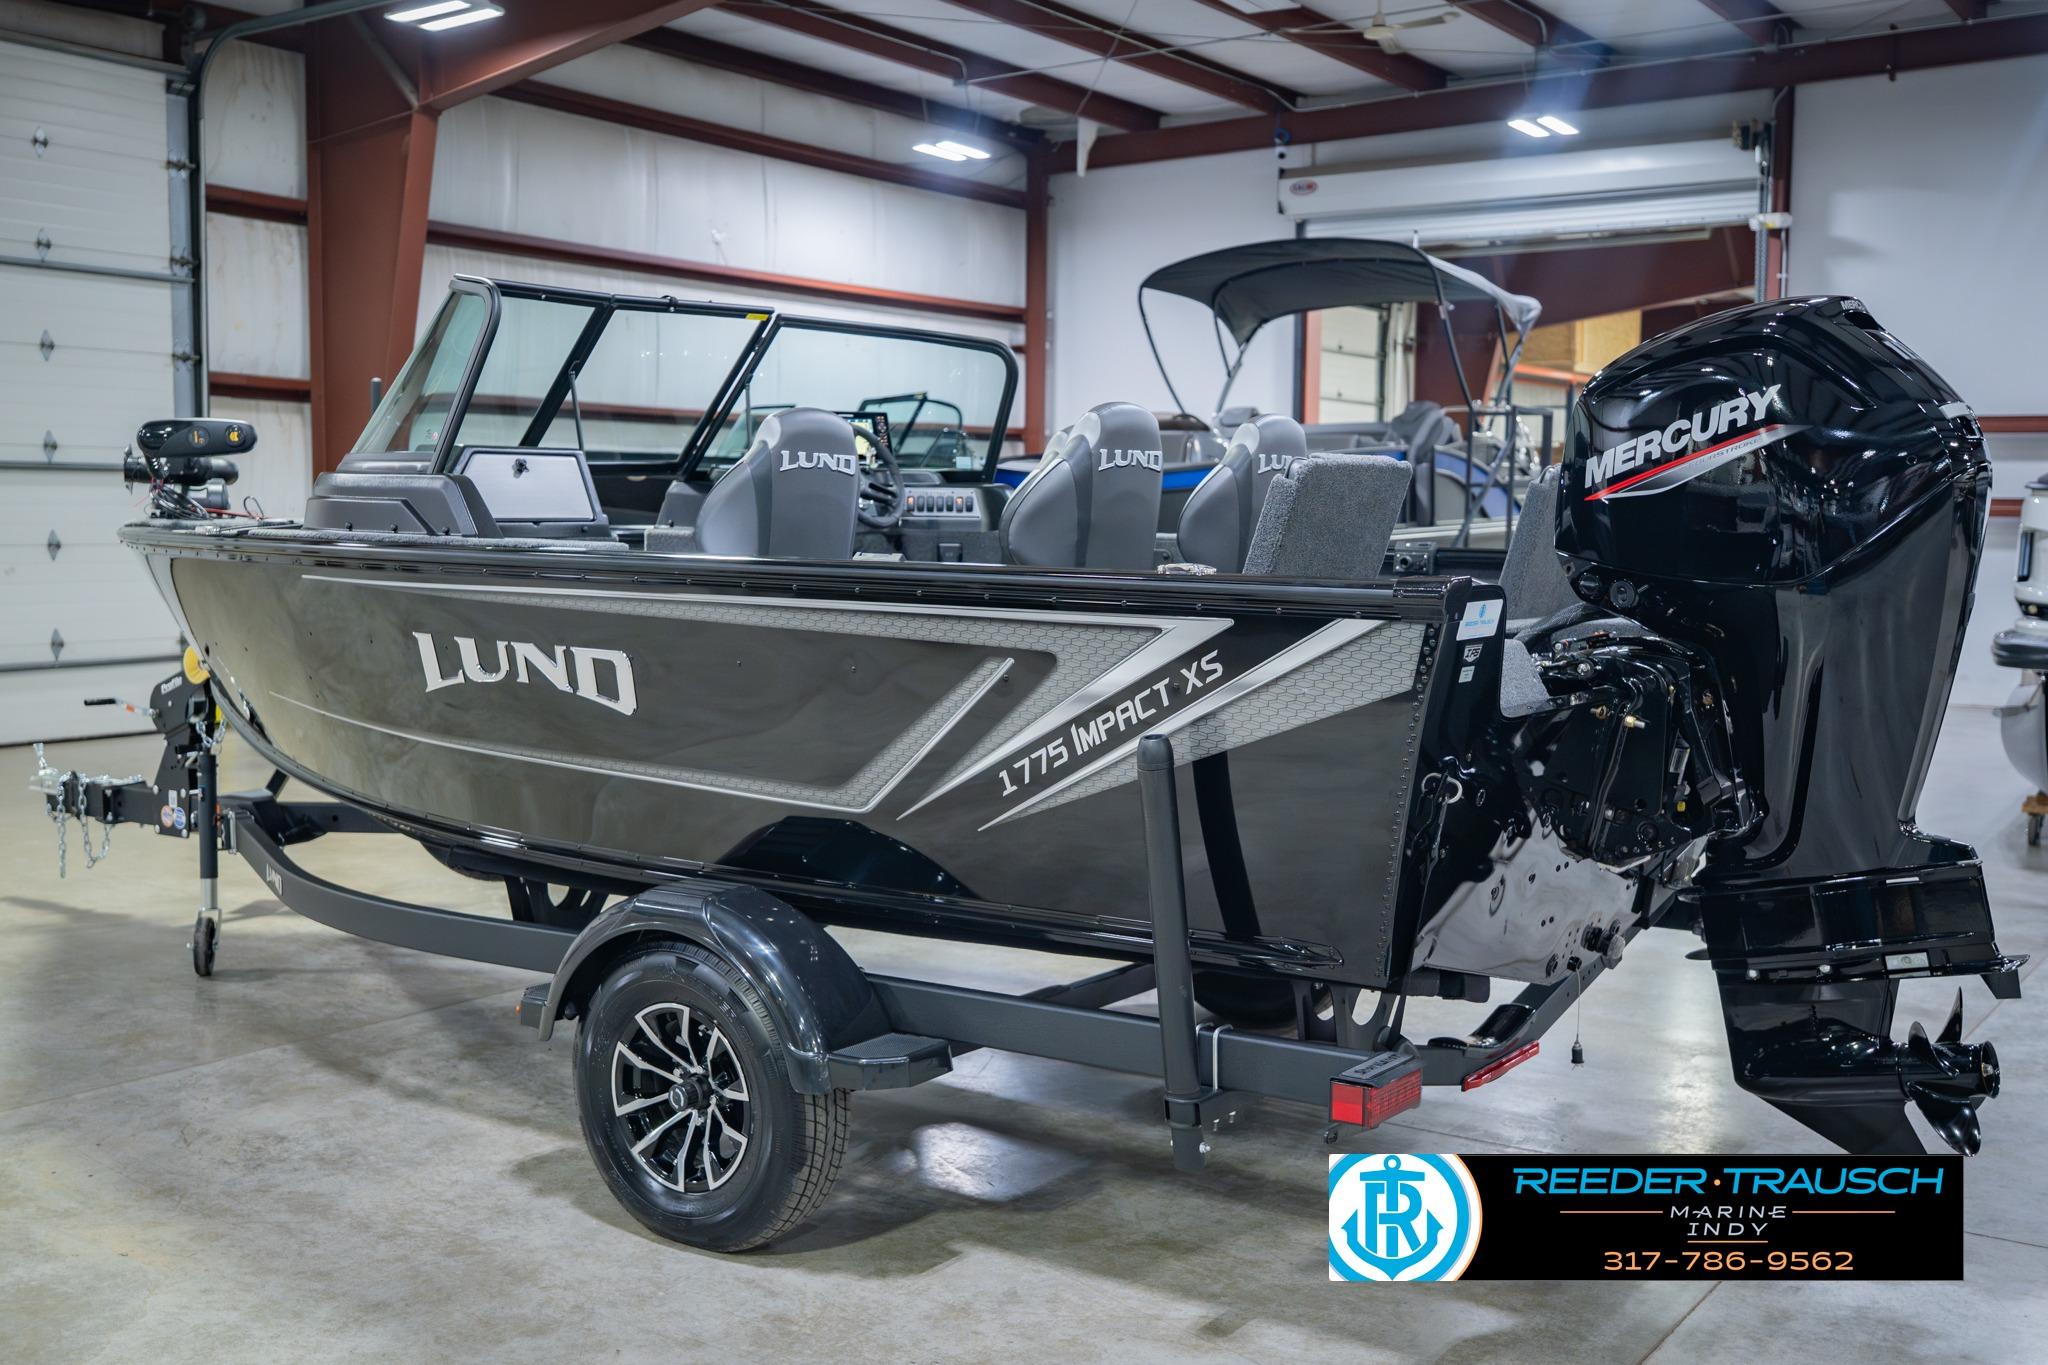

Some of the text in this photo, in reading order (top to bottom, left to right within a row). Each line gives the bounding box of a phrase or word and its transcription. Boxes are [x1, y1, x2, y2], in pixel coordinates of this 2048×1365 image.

[780, 449, 857, 476] LUND
[1098, 449, 1162, 472] LUND
[1584, 383, 1782, 488] MERCURY
[412, 631, 638, 716] LUND
[998, 649, 1223, 797] 1775 IMPACT XS
